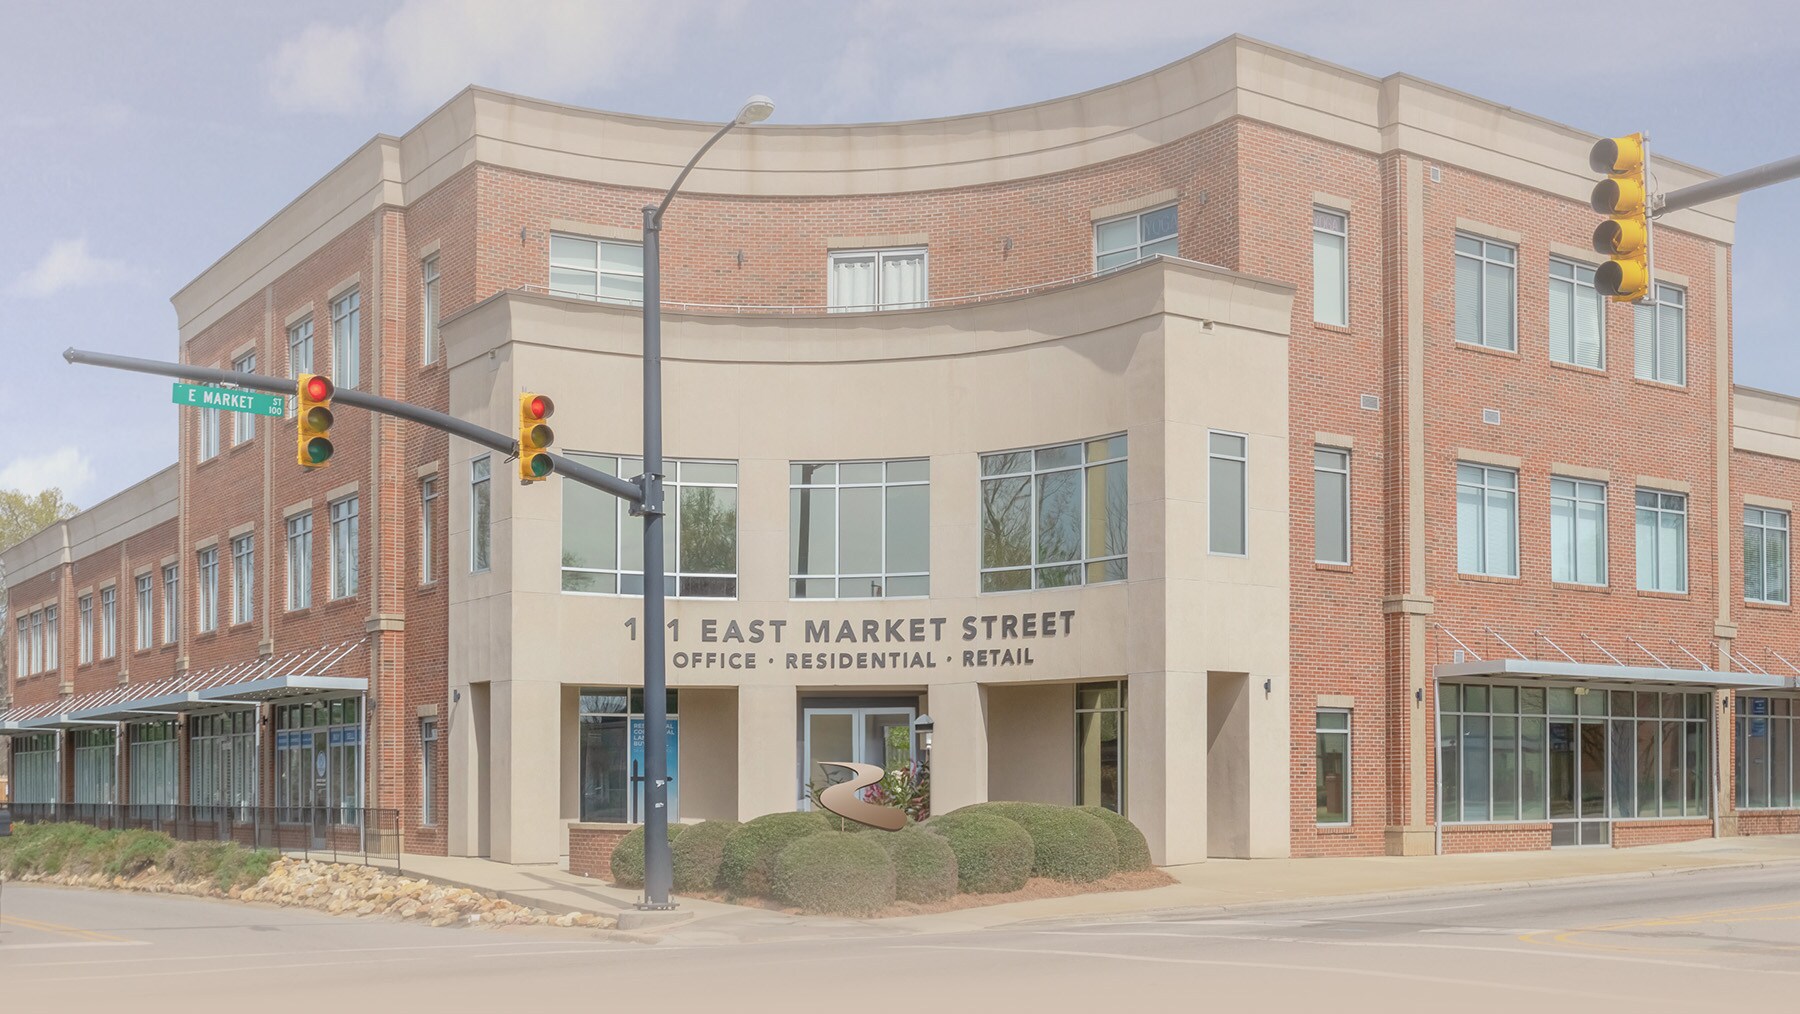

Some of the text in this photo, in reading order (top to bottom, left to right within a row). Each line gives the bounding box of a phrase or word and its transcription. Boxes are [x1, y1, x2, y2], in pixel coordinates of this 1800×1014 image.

[188, 389, 282, 409] E MARKET ST
[269, 406, 282, 415] 100
[624, 610, 1075, 643] 11 EAST MARKET STREET
[672, 648, 1034, 669] OFFICE RESIDENTIAL RETAIL
